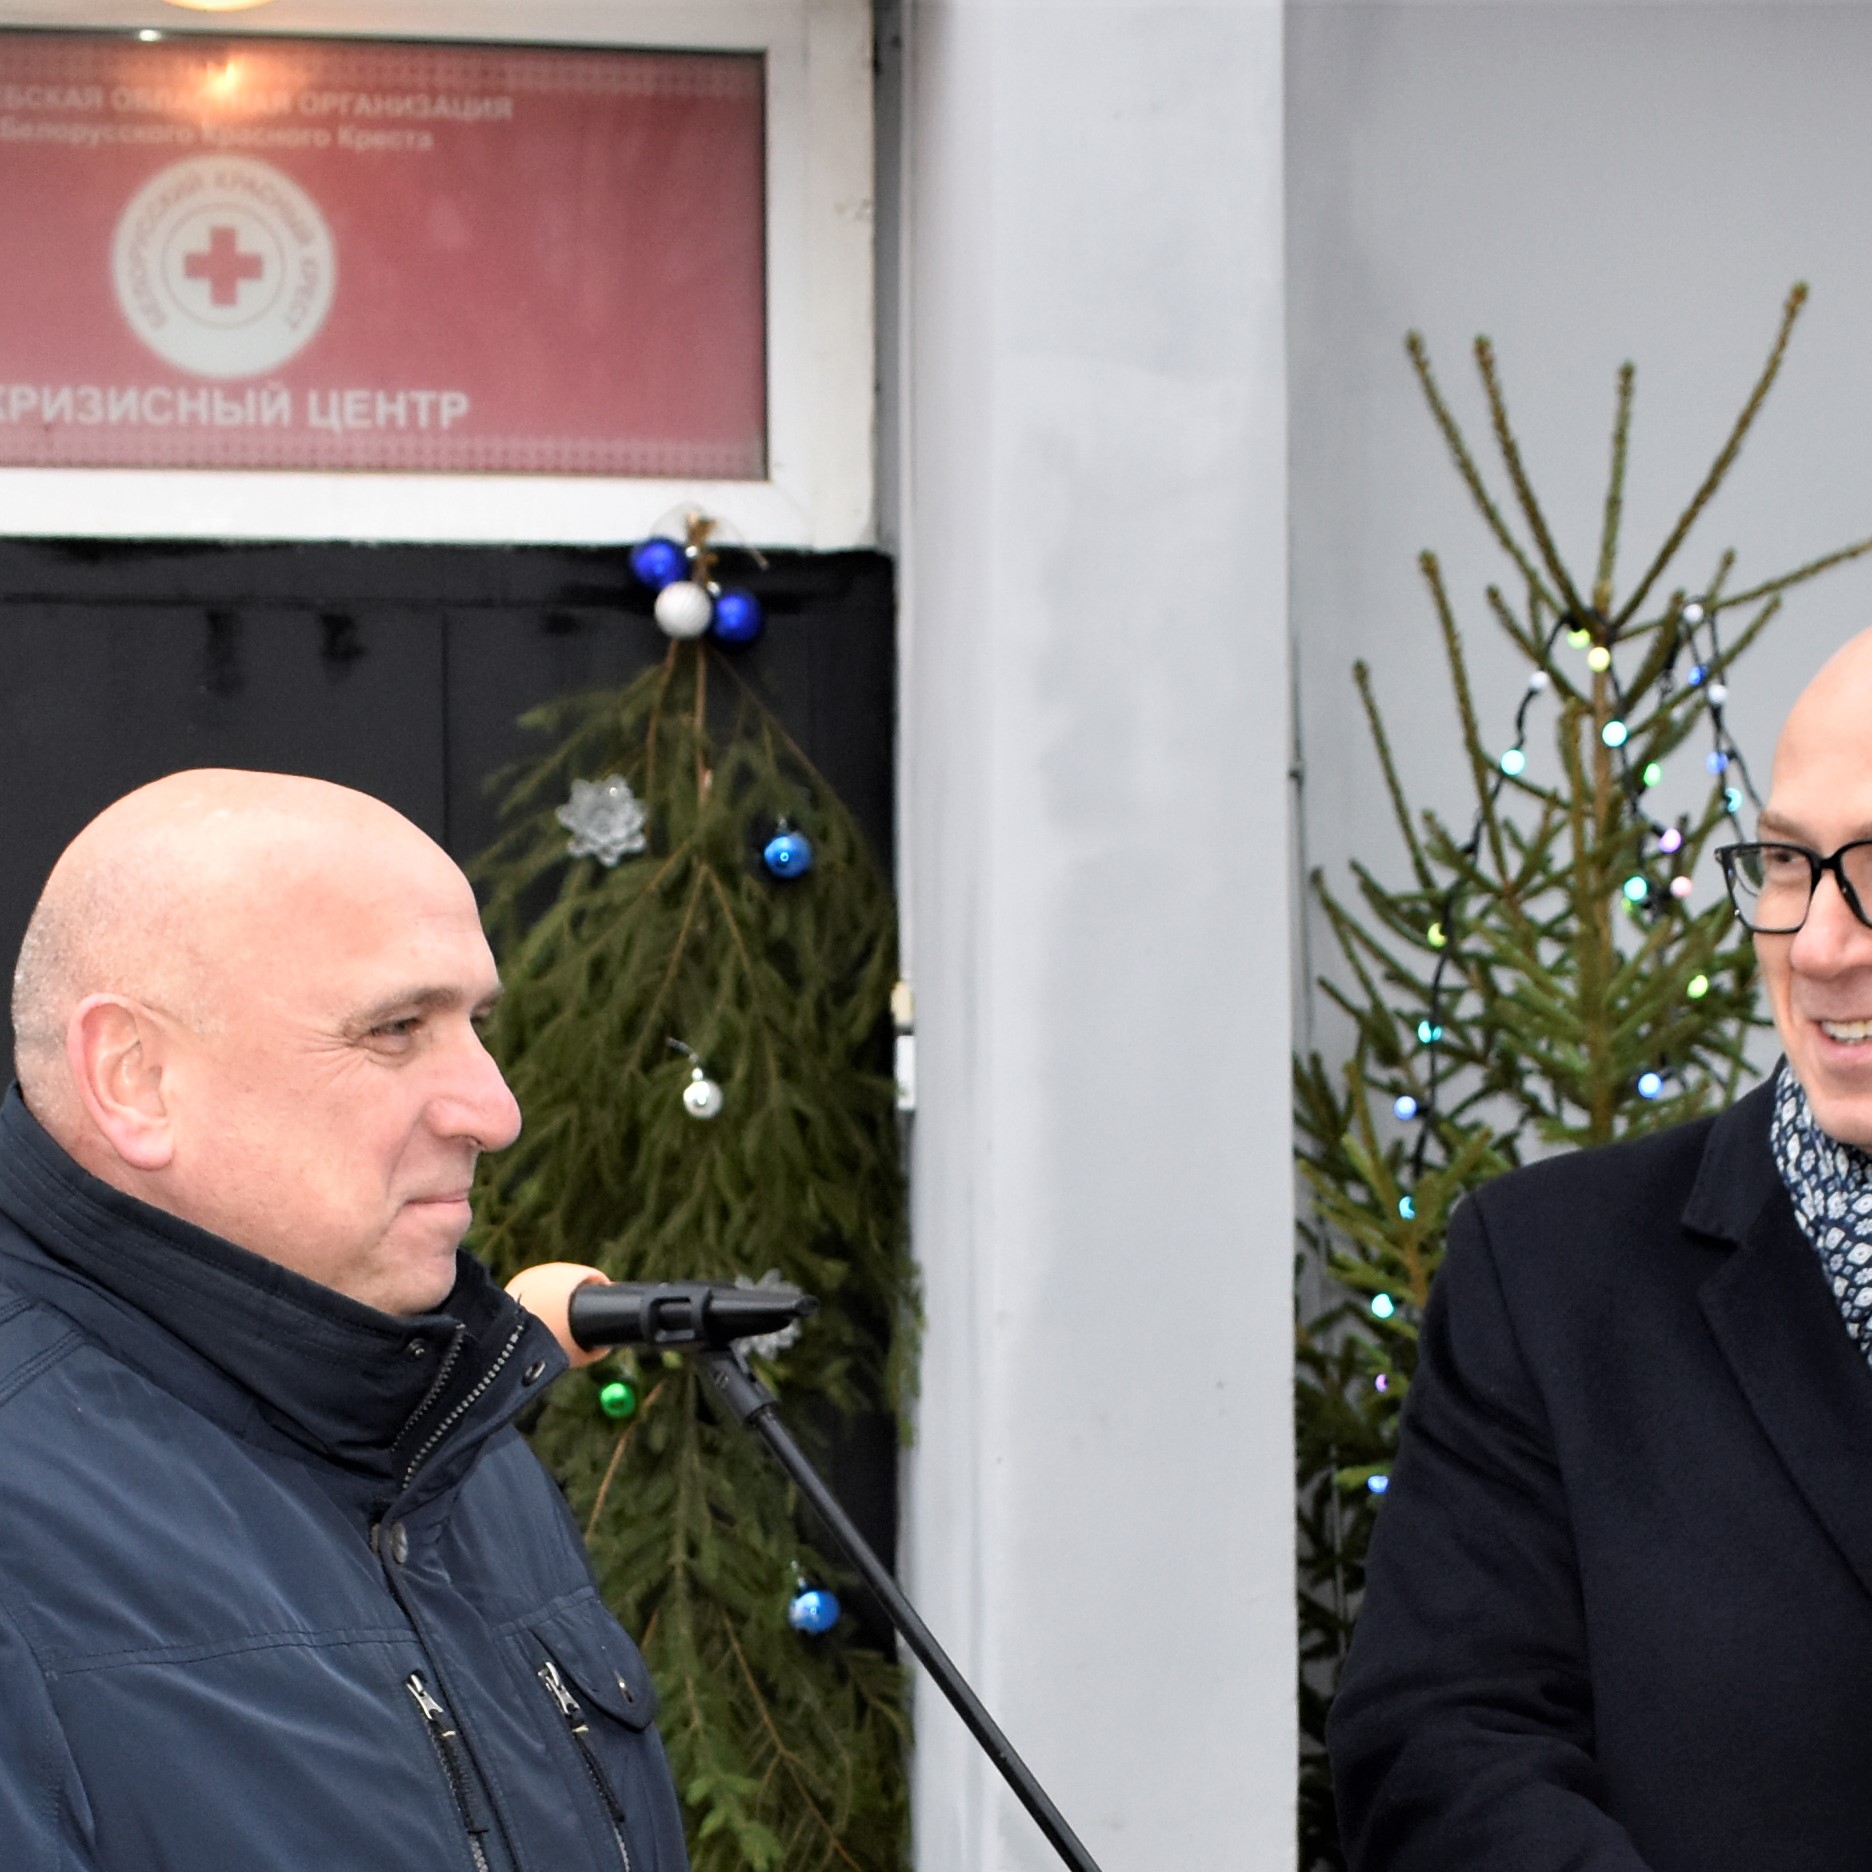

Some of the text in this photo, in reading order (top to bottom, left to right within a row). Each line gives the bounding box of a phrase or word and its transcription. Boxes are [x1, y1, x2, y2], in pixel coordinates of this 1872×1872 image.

[296, 91, 512, 122] ОРГАНИЗАЦИЯ
[337, 125, 433, 153] Креста
[308, 389, 469, 432] ЦЕНТР
